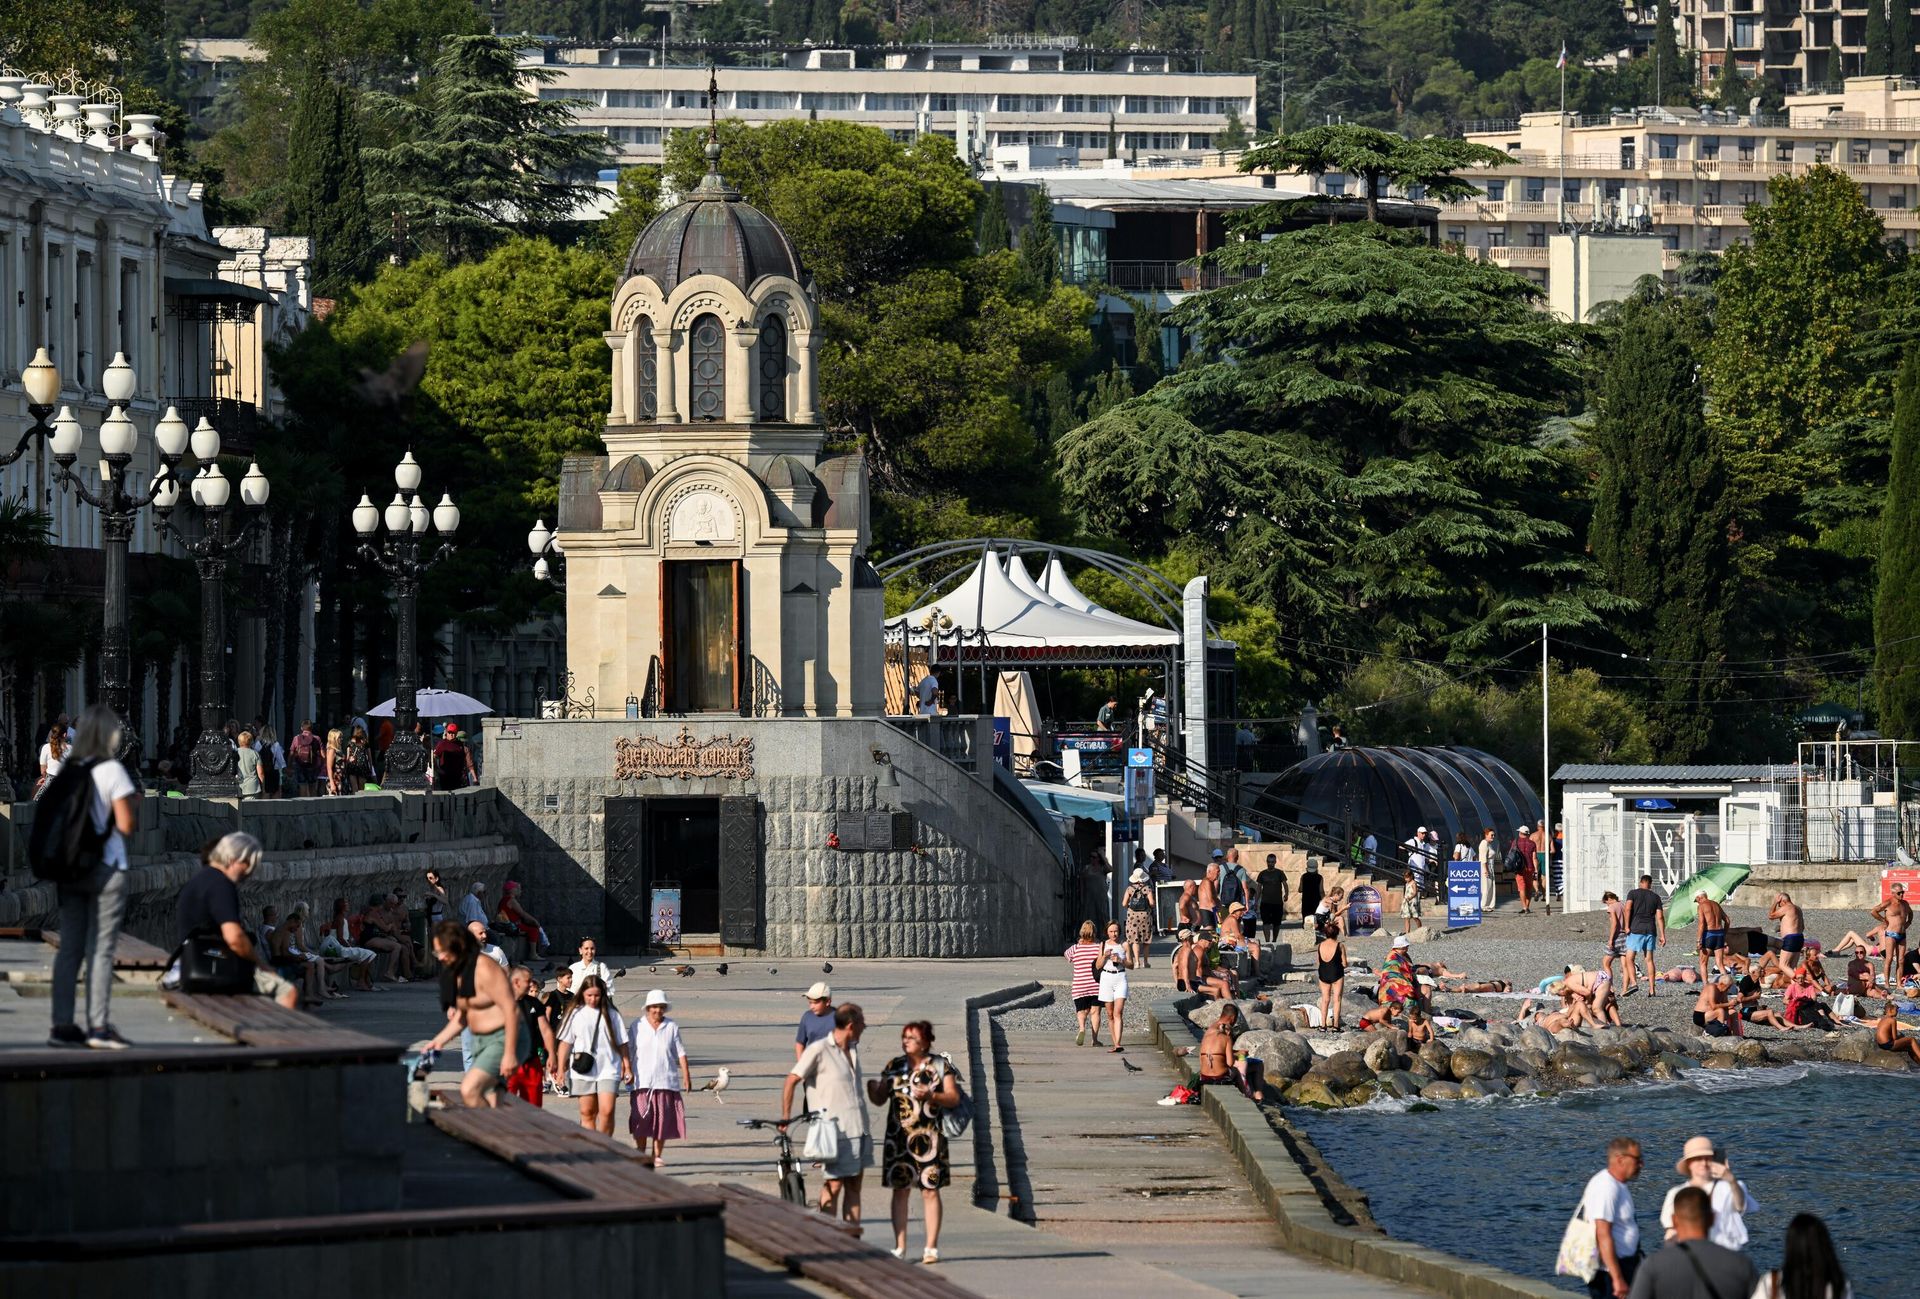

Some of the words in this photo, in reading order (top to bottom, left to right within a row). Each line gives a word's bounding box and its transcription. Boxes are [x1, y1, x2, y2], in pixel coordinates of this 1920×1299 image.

[1074, 741, 1108, 750] ФЕСТИВАЛЬ
[624, 748, 696, 766] ЦЕРКОВНАЯ
[701, 747, 741, 766] ЛАВКА
[1450, 869, 1480, 878] КАССА
